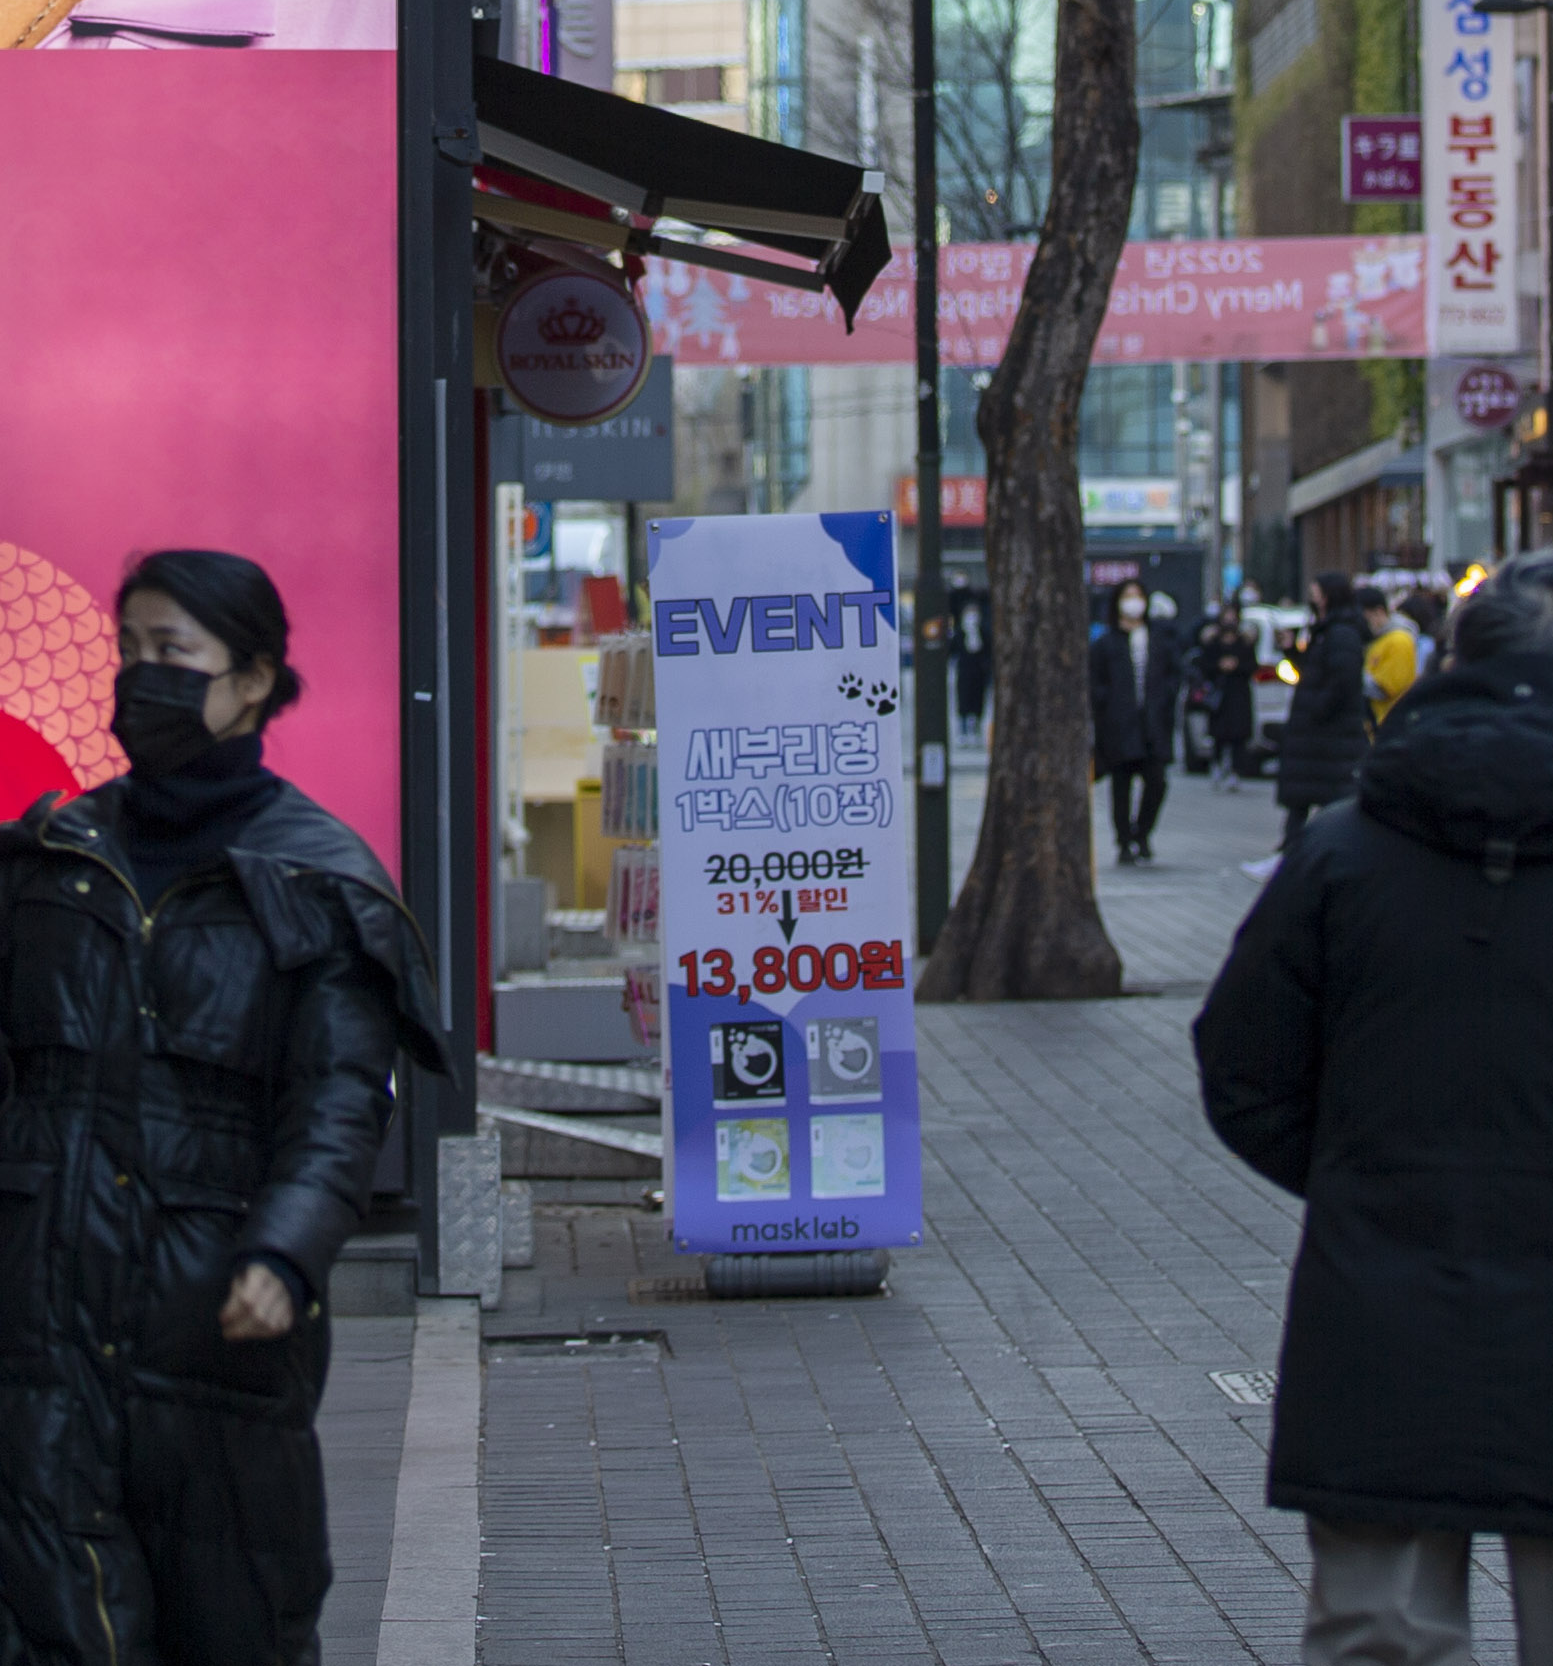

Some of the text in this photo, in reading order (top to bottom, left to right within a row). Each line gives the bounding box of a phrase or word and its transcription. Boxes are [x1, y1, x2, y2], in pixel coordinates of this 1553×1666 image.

[509, 352, 636, 372] ROYAL SKIN
[655, 590, 892, 657] EVENT
[683, 720, 879, 781] 새부리형
[675, 781, 894, 832] 1박스(10장)
[704, 847, 870, 888] 20,000원
[716, 888, 849, 916] 31% 할인
[679, 939, 905, 1005] 13,800원
[731, 1215, 861, 1243] masklab
